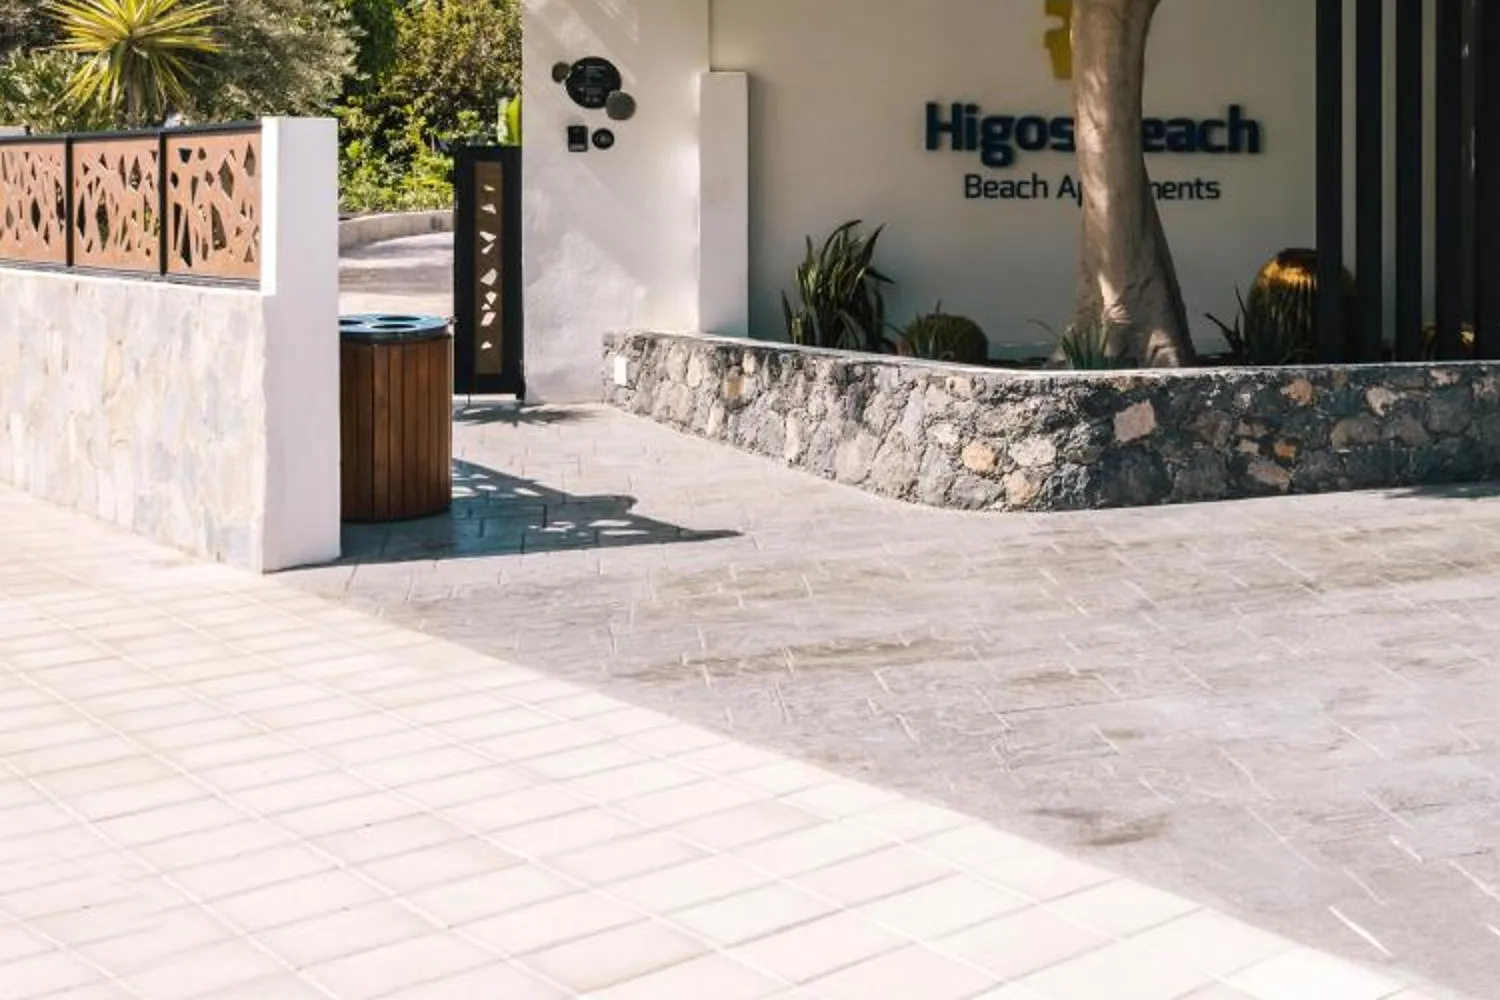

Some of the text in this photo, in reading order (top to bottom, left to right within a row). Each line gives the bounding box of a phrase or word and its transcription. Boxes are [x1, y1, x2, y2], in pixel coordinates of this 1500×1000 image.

[926, 102, 1260, 167] Higos each
[965, 172, 1221, 207] Beach Aents
